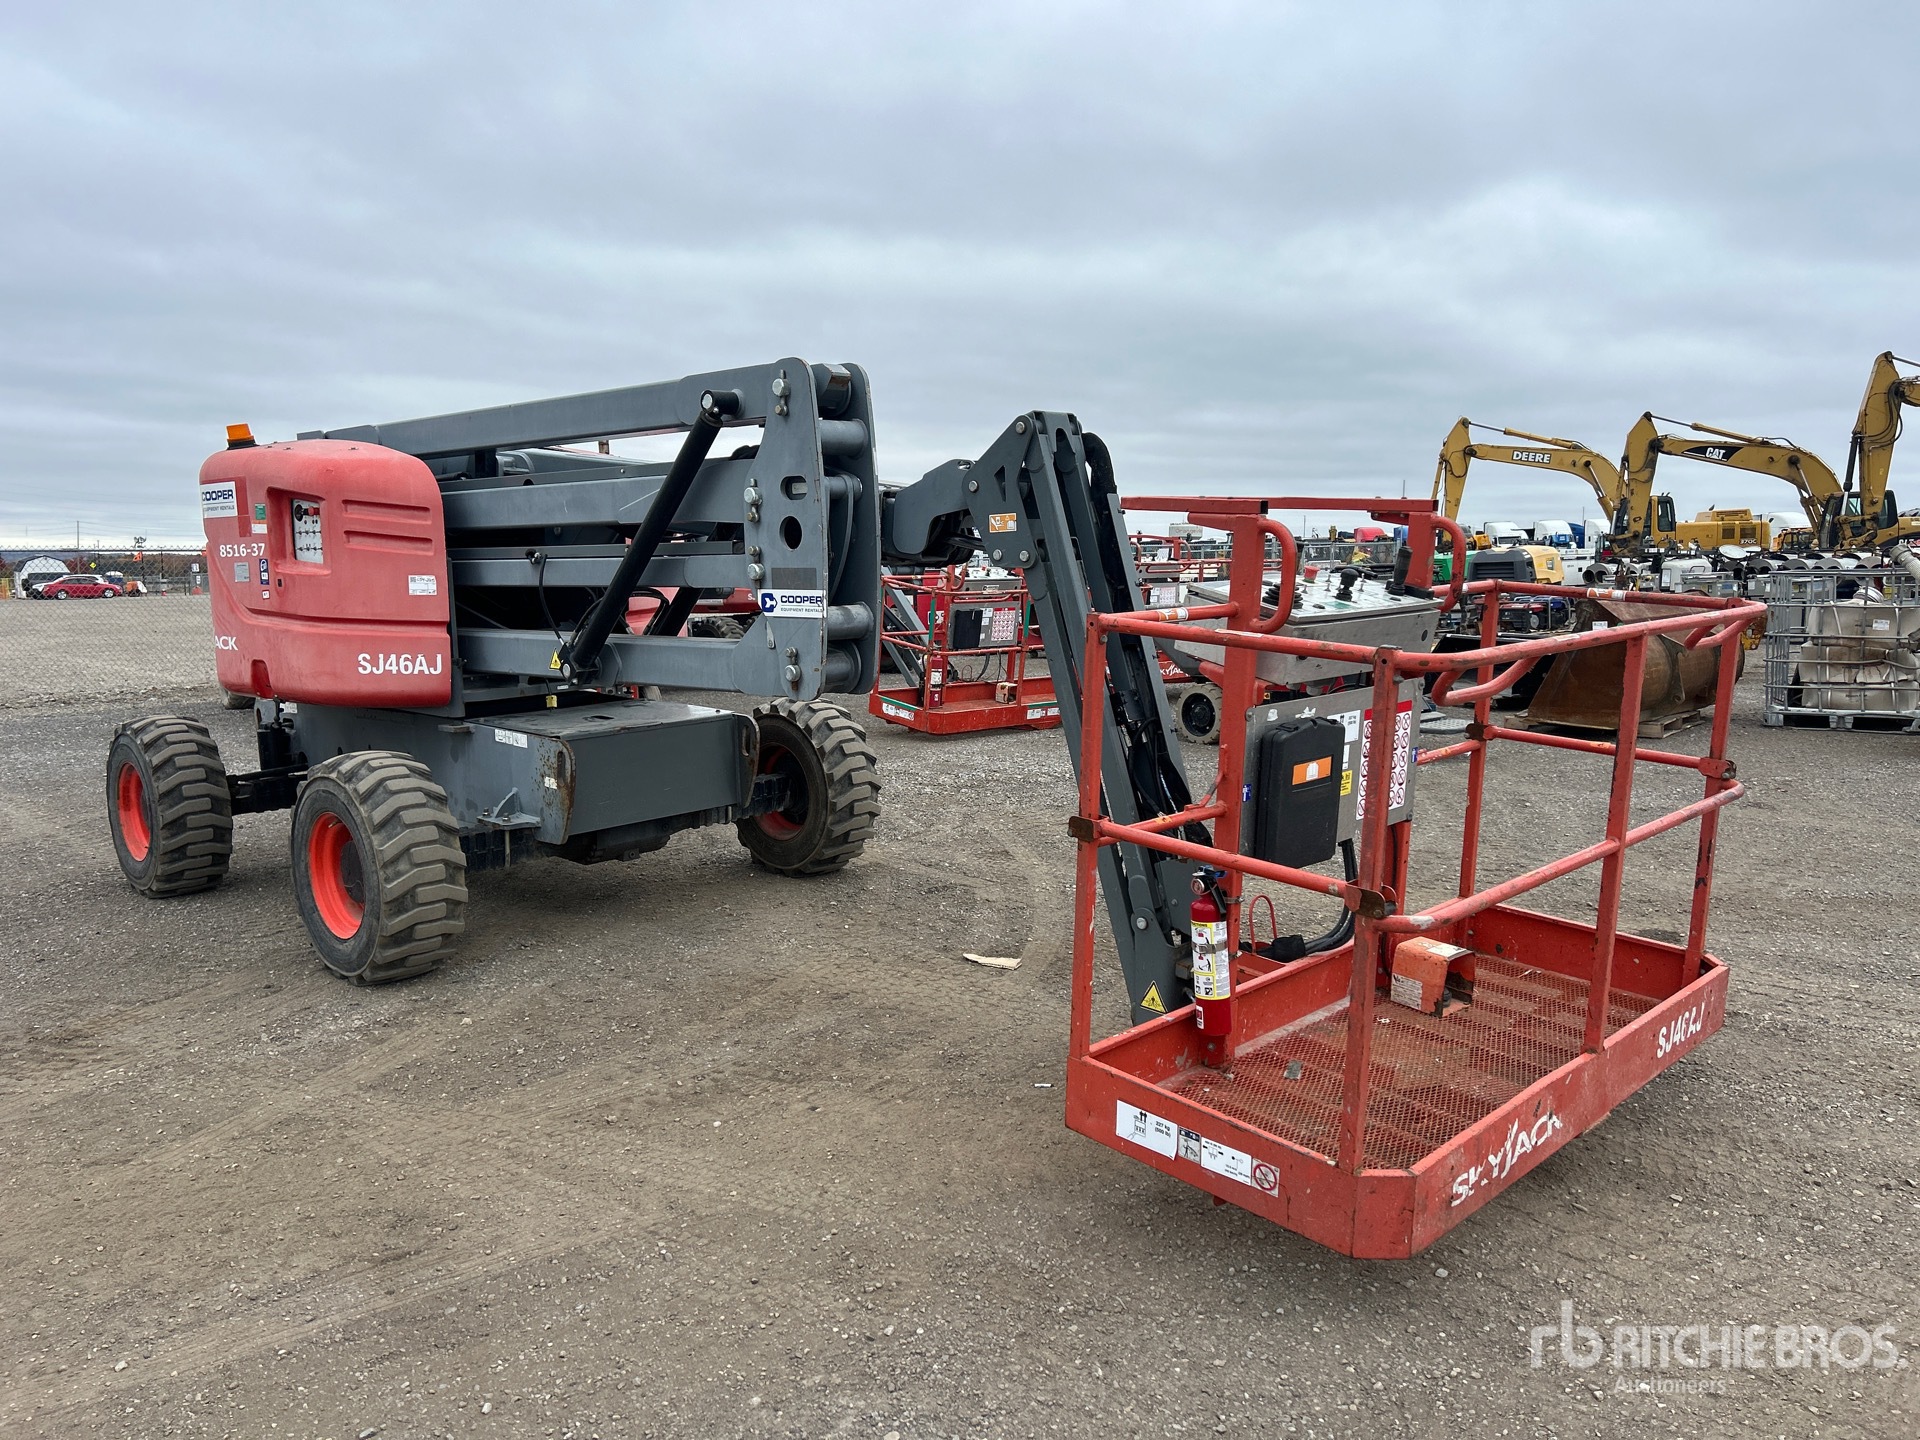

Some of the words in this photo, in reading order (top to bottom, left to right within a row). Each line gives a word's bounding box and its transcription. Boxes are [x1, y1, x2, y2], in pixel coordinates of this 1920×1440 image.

[1513, 451, 1550, 463] DEERE
[1705, 447, 1726, 459] CAT
[220, 543, 265, 557] 8516-37
[780, 595, 823, 604] COOPER
[357, 653, 442, 675] SJ46AJ
[1656, 1002, 1705, 1059] SJ46AJ
